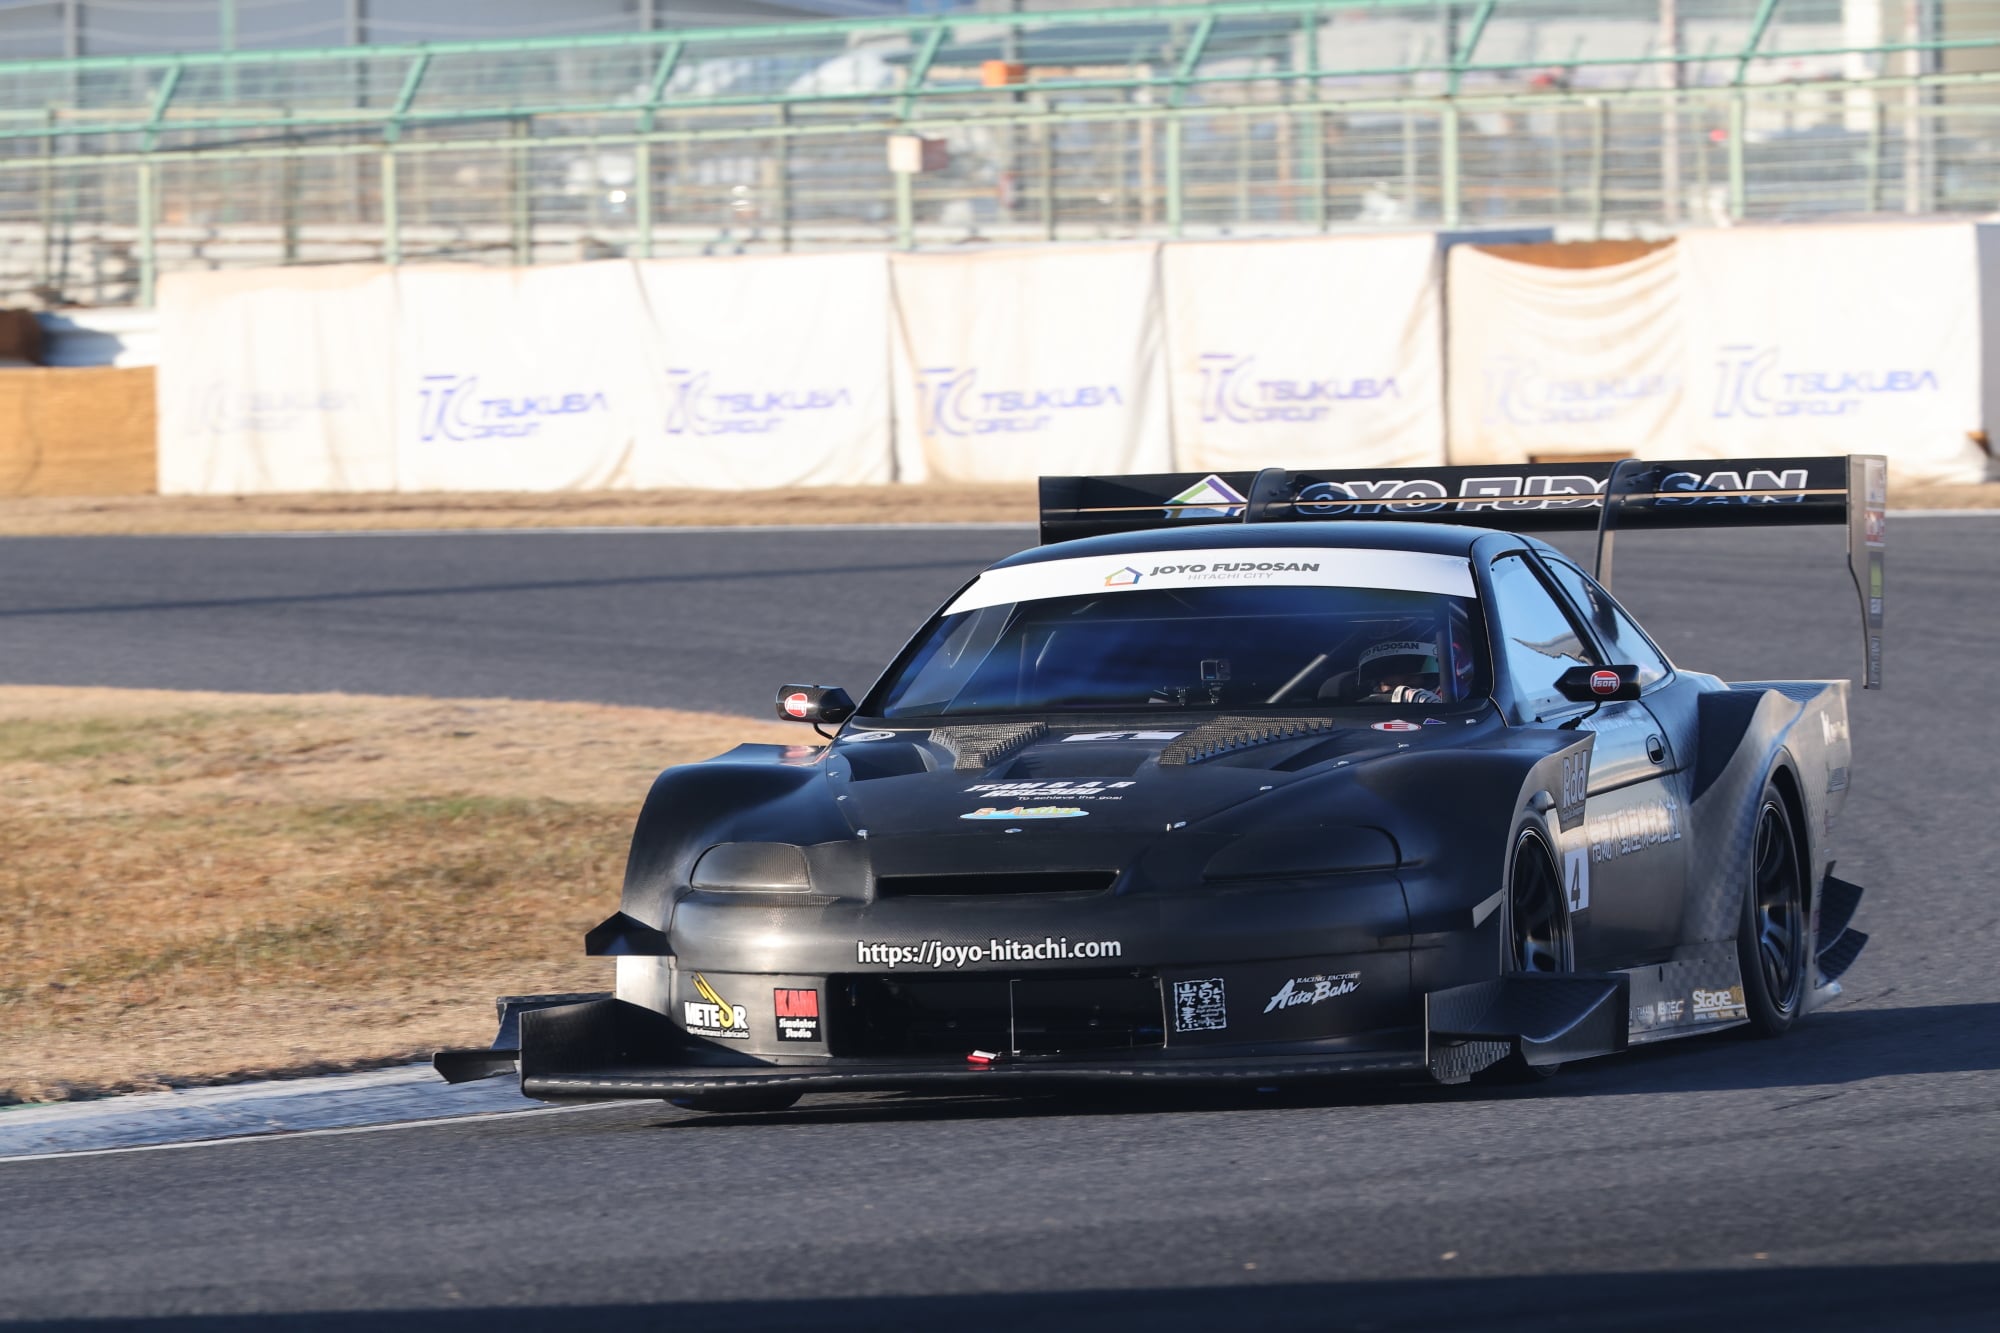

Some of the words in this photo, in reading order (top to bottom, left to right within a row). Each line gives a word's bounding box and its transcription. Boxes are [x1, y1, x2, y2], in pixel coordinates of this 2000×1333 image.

[1257, 376, 1401, 401] TSUKUBA
[1782, 370, 1939, 393] TSUKUBA
[981, 386, 1122, 411] TSUKUBA
[1296, 480, 1447, 515] OYO
[1456, 469, 1809, 512] FUDSAN
[1150, 564, 1206, 577] JOYO
[1212, 562, 1321, 572] FUDOSAN
[1188, 573, 1240, 581] HITACHI
[1243, 572, 1275, 580] CITY
[1571, 857, 1581, 909] 4
[857, 938, 1122, 968] https://joyo-hitachi.com
[1296, 974, 1326, 983] RACING
[1327, 971, 1360, 981] FACTORY
[1692, 989, 1732, 1009] Stage
[779, 1019, 816, 1028] Simulator
[785, 1029, 812, 1038] Studio
